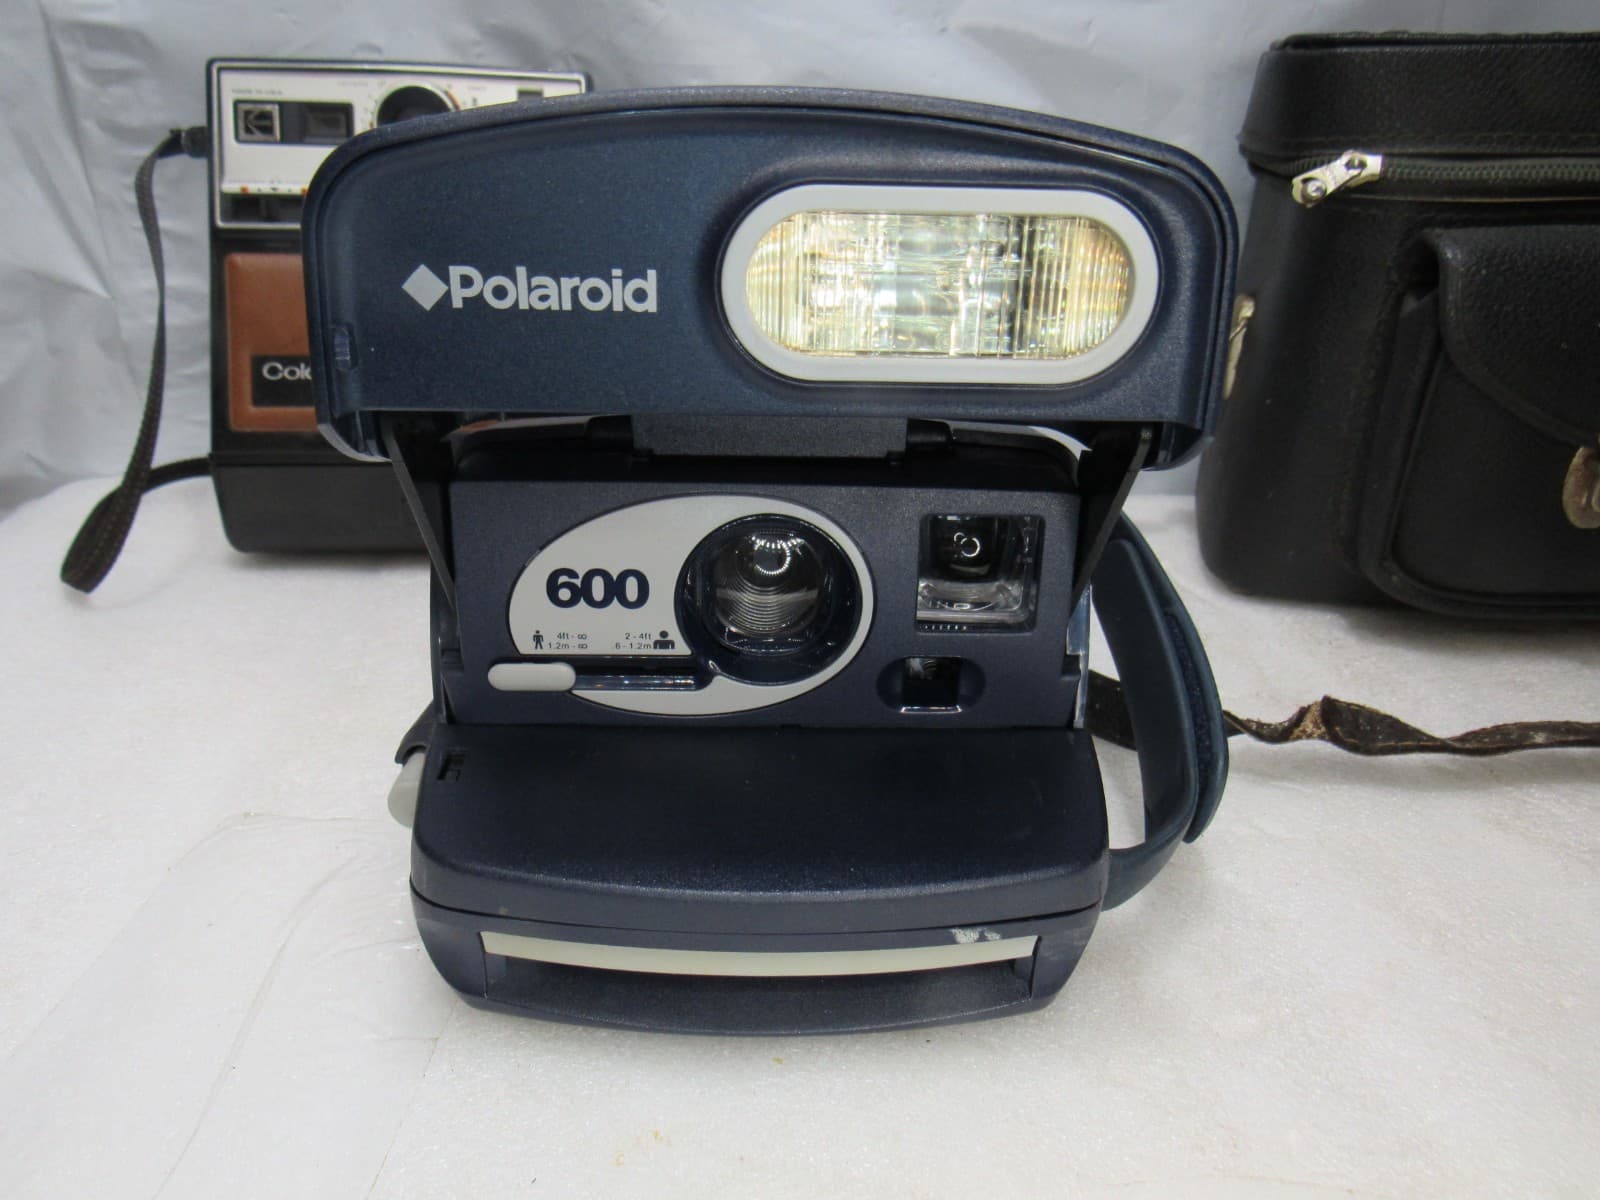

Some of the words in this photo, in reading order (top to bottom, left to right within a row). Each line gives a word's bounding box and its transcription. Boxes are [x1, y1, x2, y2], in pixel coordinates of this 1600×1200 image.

[449, 265, 657, 313] Polaroid
[546, 567, 650, 610] 600
[557, 632, 569, 640] 4ft
[625, 632, 631, 640] 2
[638, 632, 652, 640] 4ft
